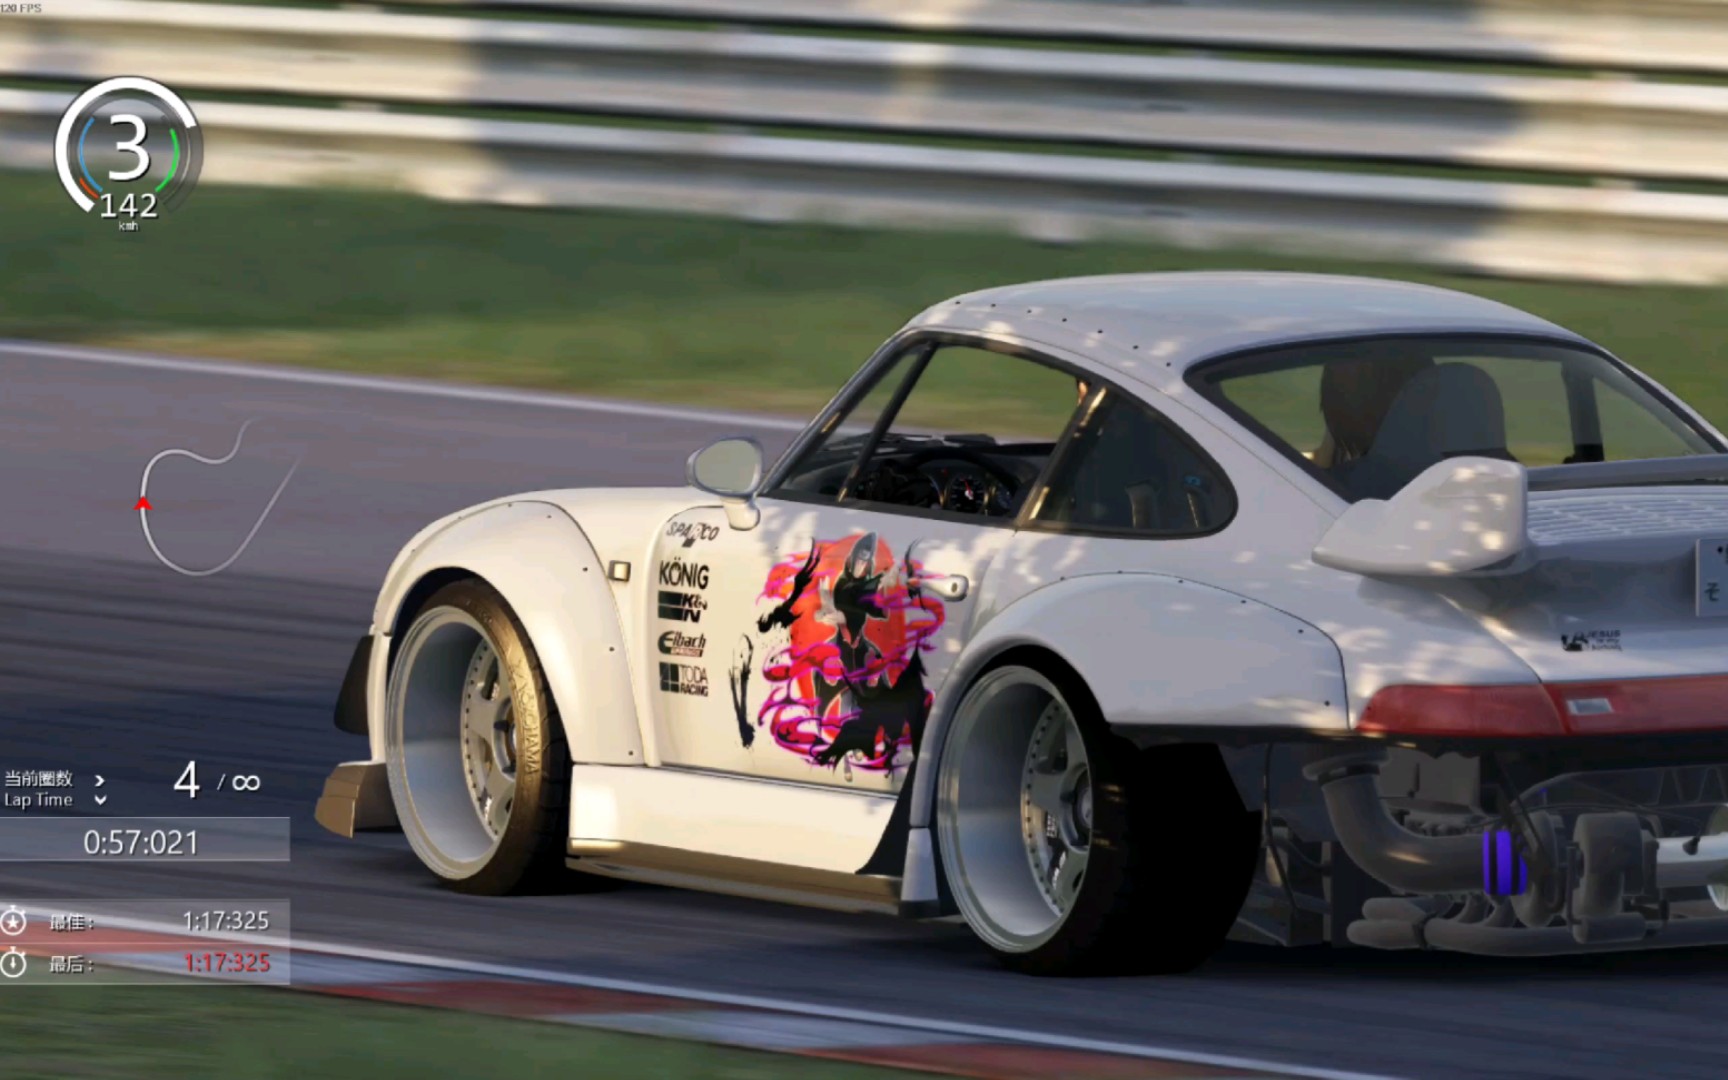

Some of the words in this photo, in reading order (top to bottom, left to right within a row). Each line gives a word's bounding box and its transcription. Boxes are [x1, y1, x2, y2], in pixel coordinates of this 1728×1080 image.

[659, 556, 710, 590] KÖNIG
[657, 630, 707, 657] Eibach
[680, 664, 708, 684] TODA
[680, 681, 708, 697] RACING
